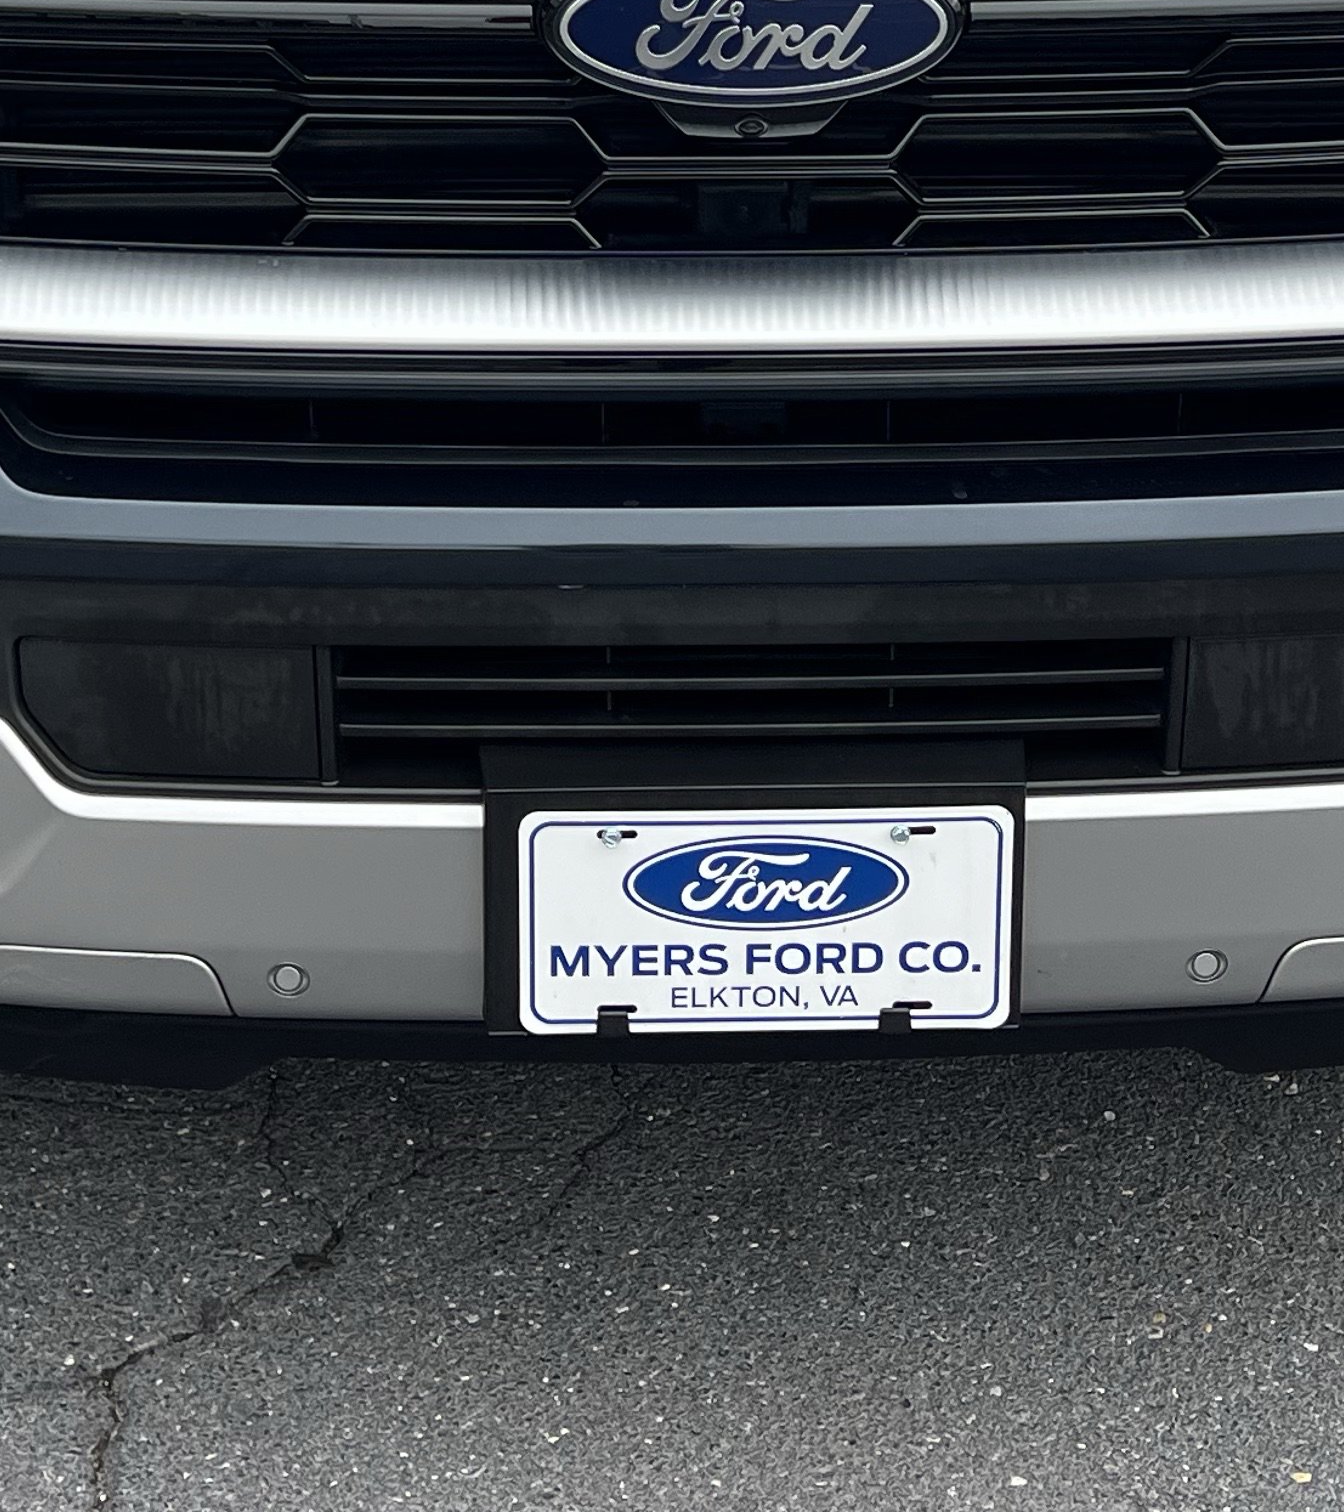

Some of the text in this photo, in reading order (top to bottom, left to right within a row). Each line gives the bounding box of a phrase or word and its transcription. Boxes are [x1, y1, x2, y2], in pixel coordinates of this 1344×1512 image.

[680, 850, 853, 913] Ford
[549, 940, 982, 977] MYERS FORD CO.
[670, 984, 859, 1010] ELKTON, VA
